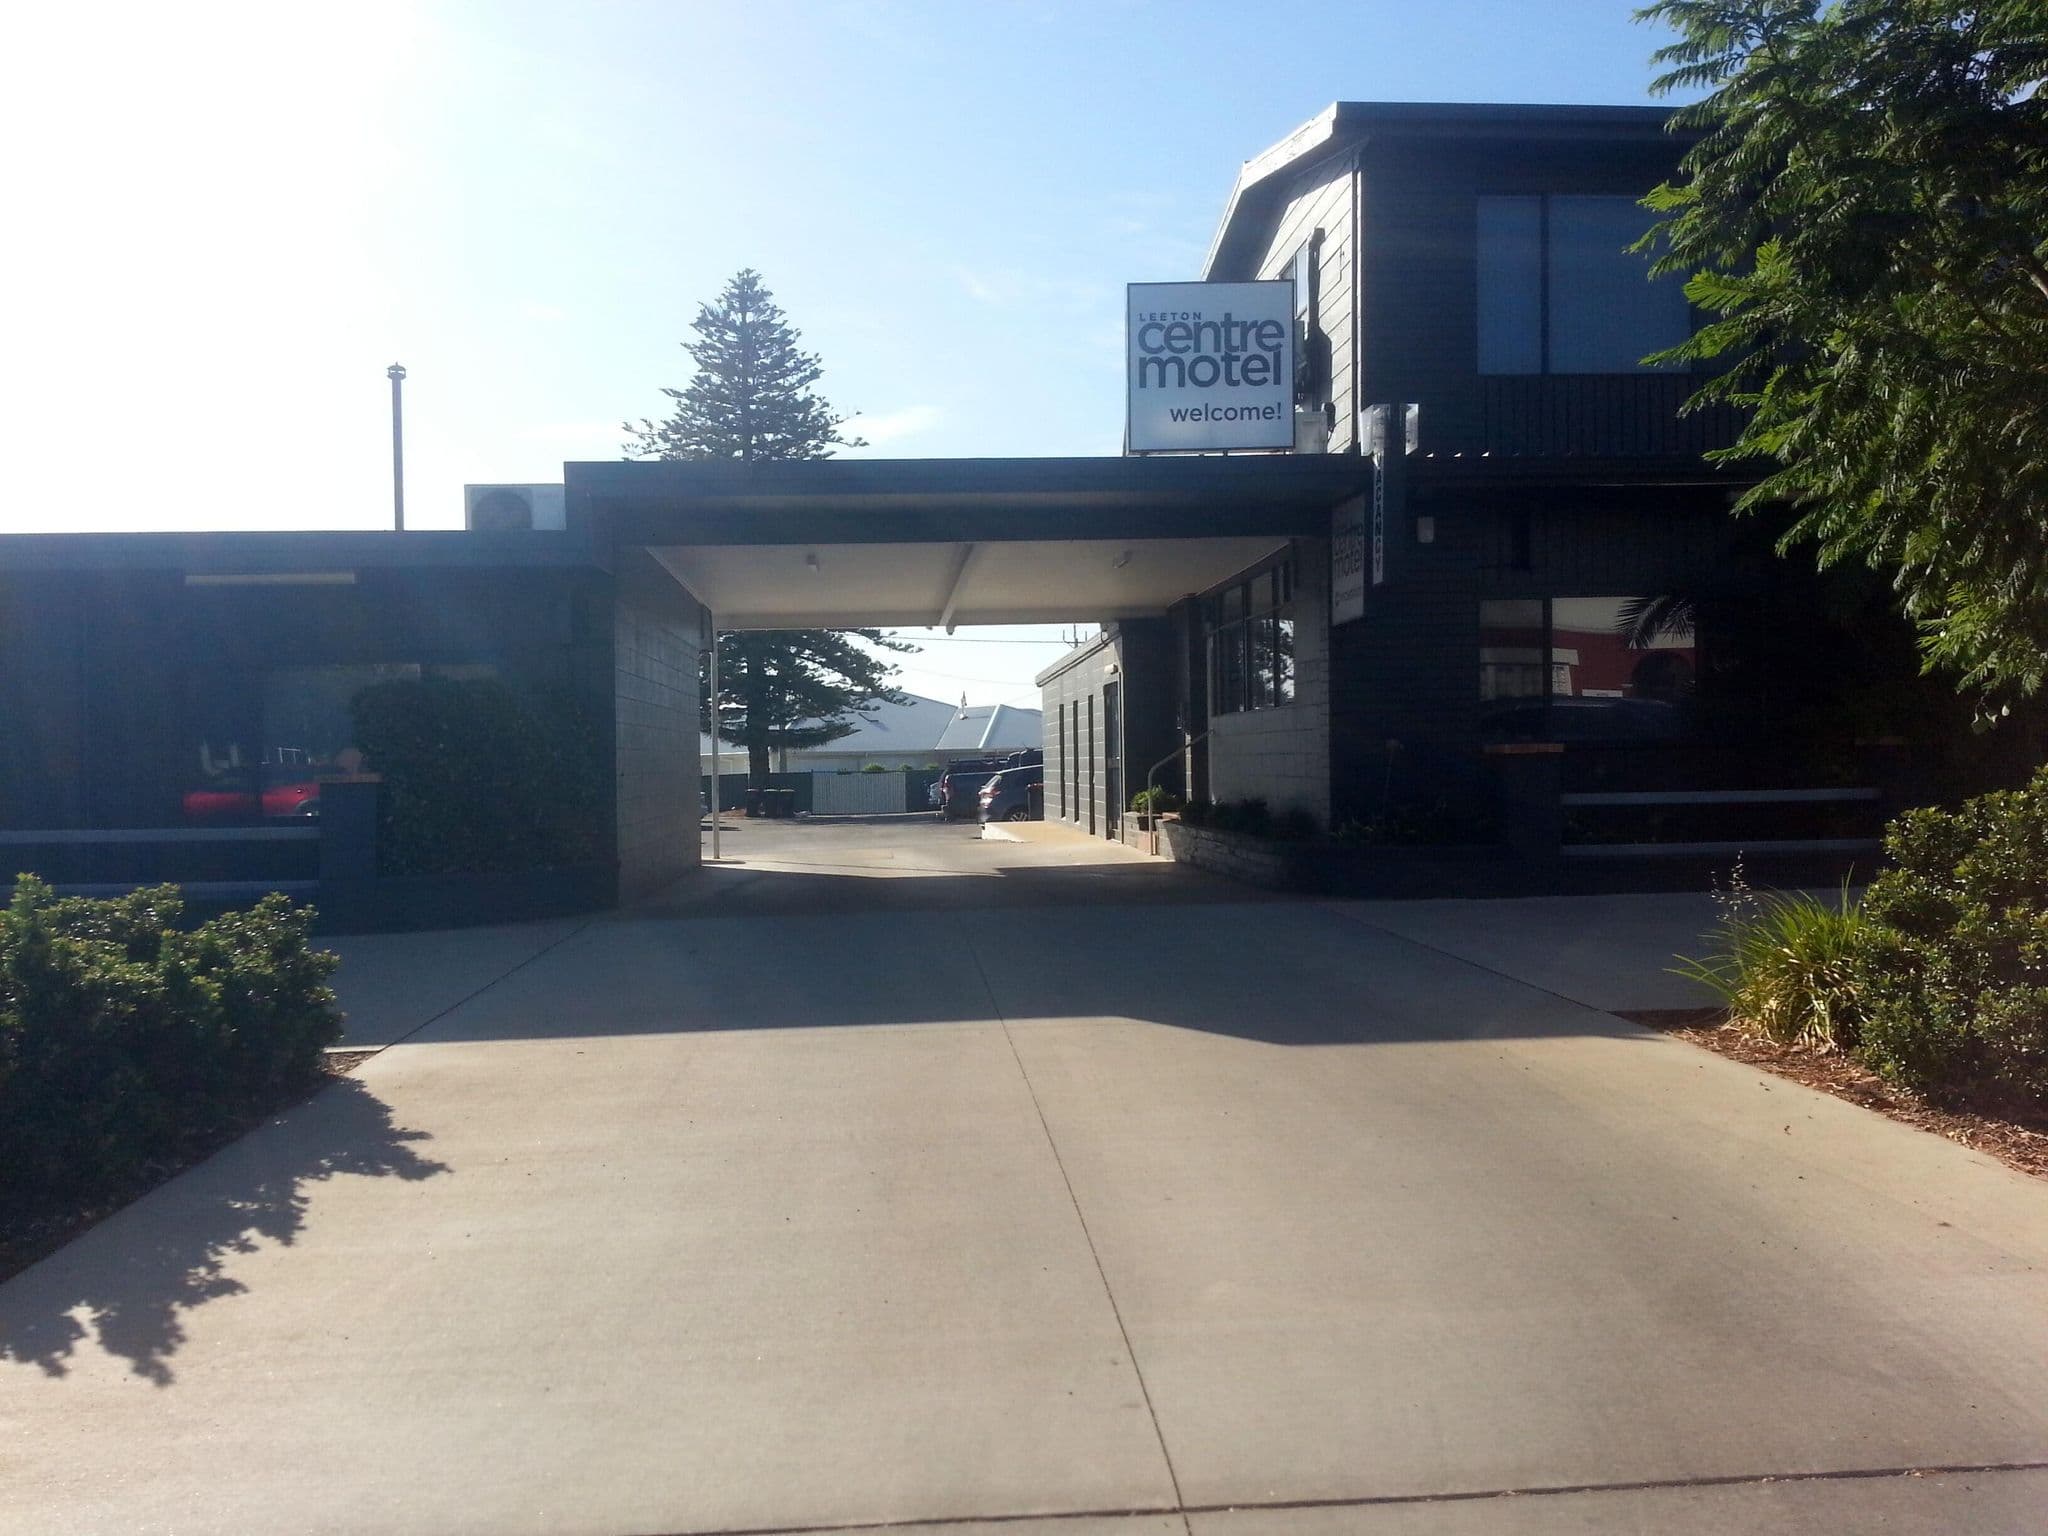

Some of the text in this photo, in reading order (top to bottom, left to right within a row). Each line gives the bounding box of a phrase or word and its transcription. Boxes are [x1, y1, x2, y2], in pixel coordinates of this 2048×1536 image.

[1138, 312, 1202, 321] LEETON
[1138, 313, 1284, 353] centre
[1139, 350, 1281, 388] motel
[1171, 403, 1281, 422] welcome!
